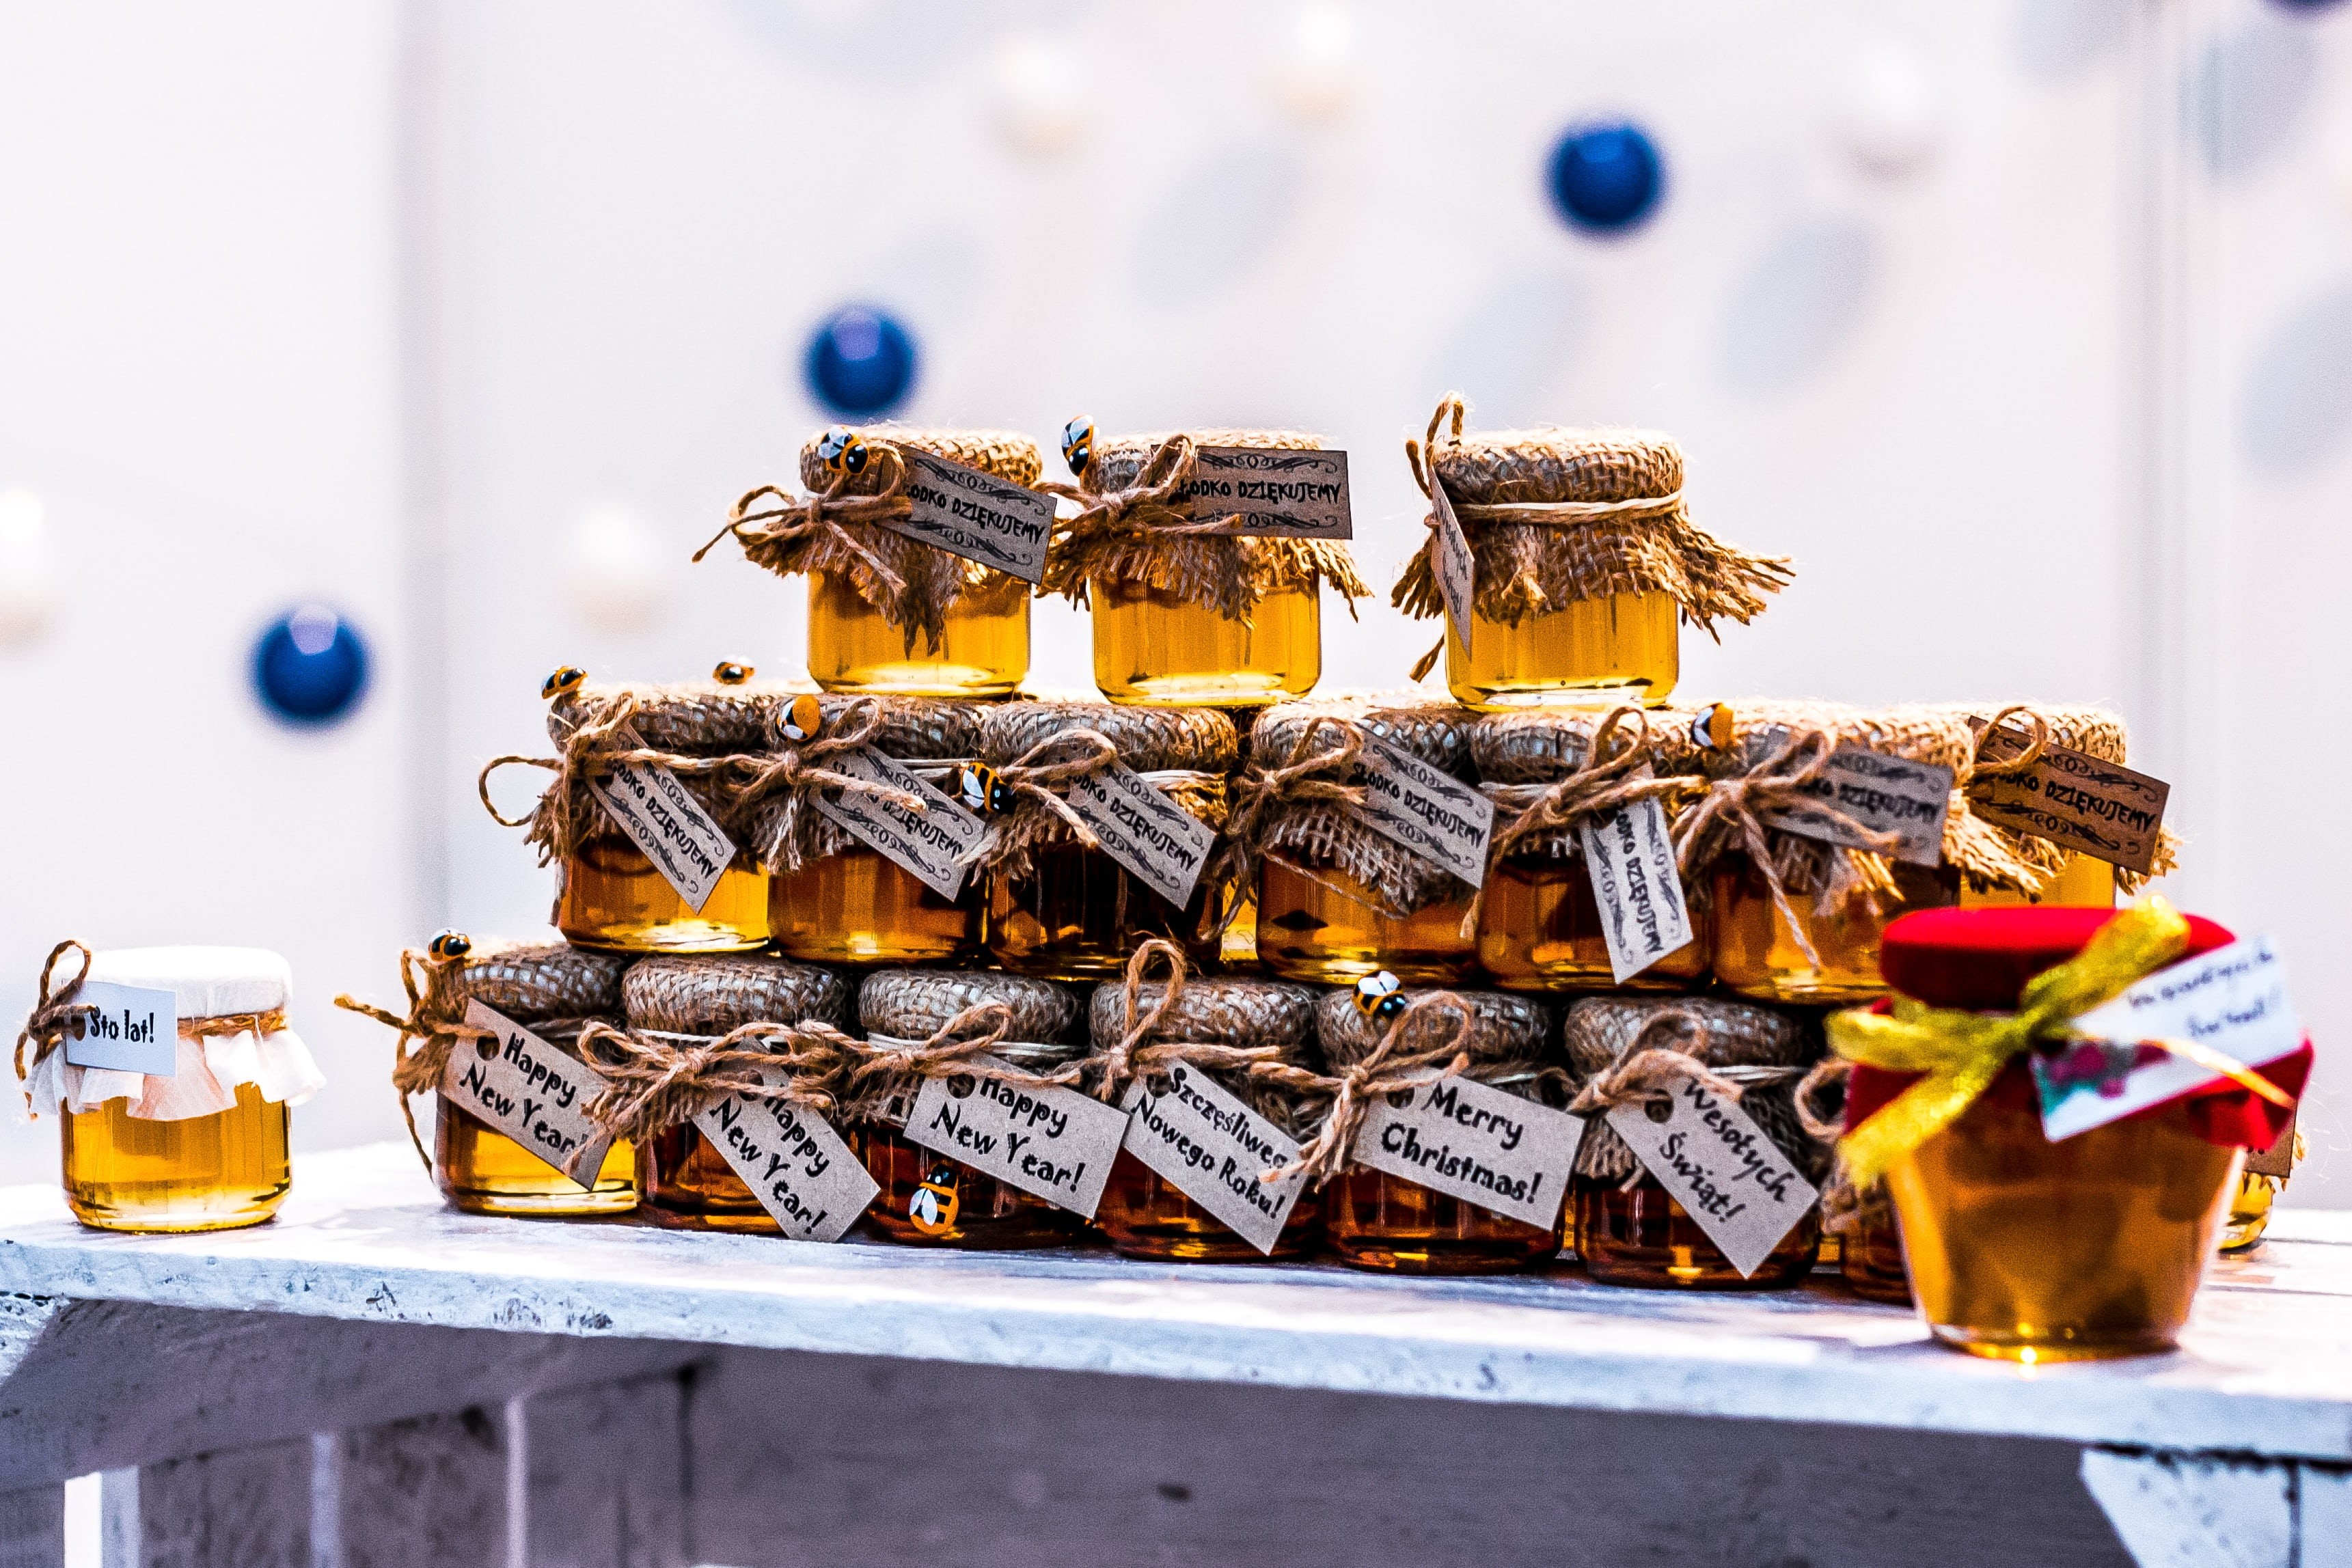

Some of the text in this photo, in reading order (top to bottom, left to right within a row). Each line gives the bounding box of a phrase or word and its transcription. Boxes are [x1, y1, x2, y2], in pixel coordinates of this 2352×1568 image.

[906, 484, 1045, 545] ODKO DZIĘKUJEMY
[1238, 480, 1341, 504] DZIĘKUJEMY
[612, 763, 717, 879] ODKO DZIĘKUJEMY
[1110, 797, 1199, 871] DZIĘKUJEMY
[1404, 790, 1486, 849] DZIĘKUJEMY
[2045, 781, 2156, 832] DZIĘKUJEMY
[90, 1006, 154, 1044] Sto lat!
[459, 1062, 515, 1116] New
[504, 1032, 577, 1108] Happy
[930, 1101, 1086, 1192] New Year!
[1421, 1082, 1523, 1150] Merry
[1684, 1077, 1795, 1202] Wesołych
[709, 1096, 828, 1235] New Year!
[1130, 1093, 1285, 1219] Nowego Roku!
[1381, 1122, 1542, 1204] Christmas!
